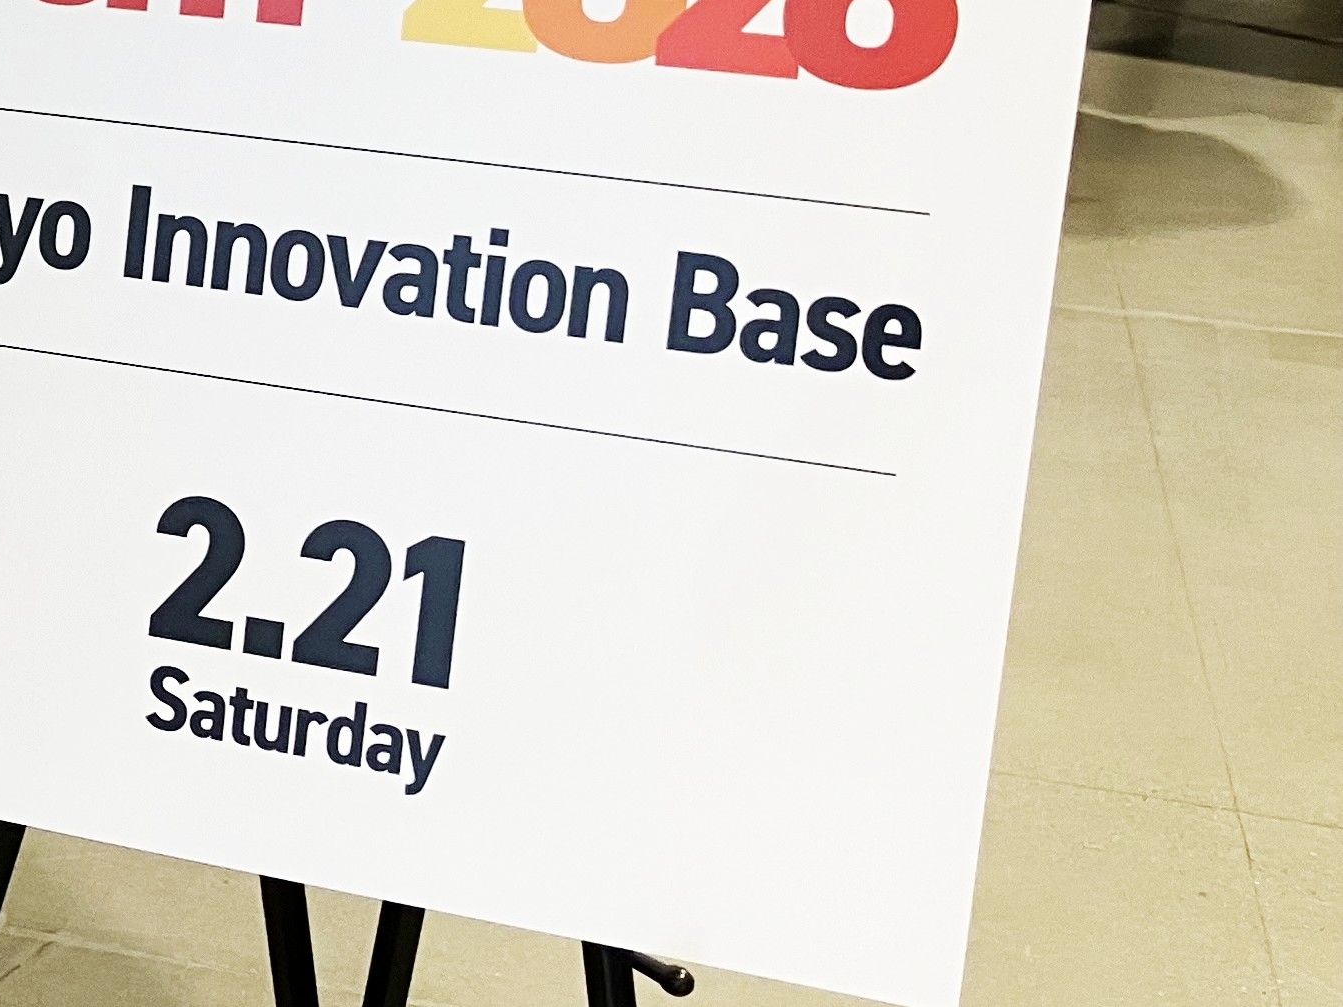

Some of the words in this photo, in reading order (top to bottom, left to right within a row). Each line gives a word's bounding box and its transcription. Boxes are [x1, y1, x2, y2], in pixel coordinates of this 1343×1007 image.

[123, 184, 630, 343] Innovation
[667, 251, 923, 381] Base
[148, 495, 465, 689] 2.21
[147, 665, 445, 796] Saturday
